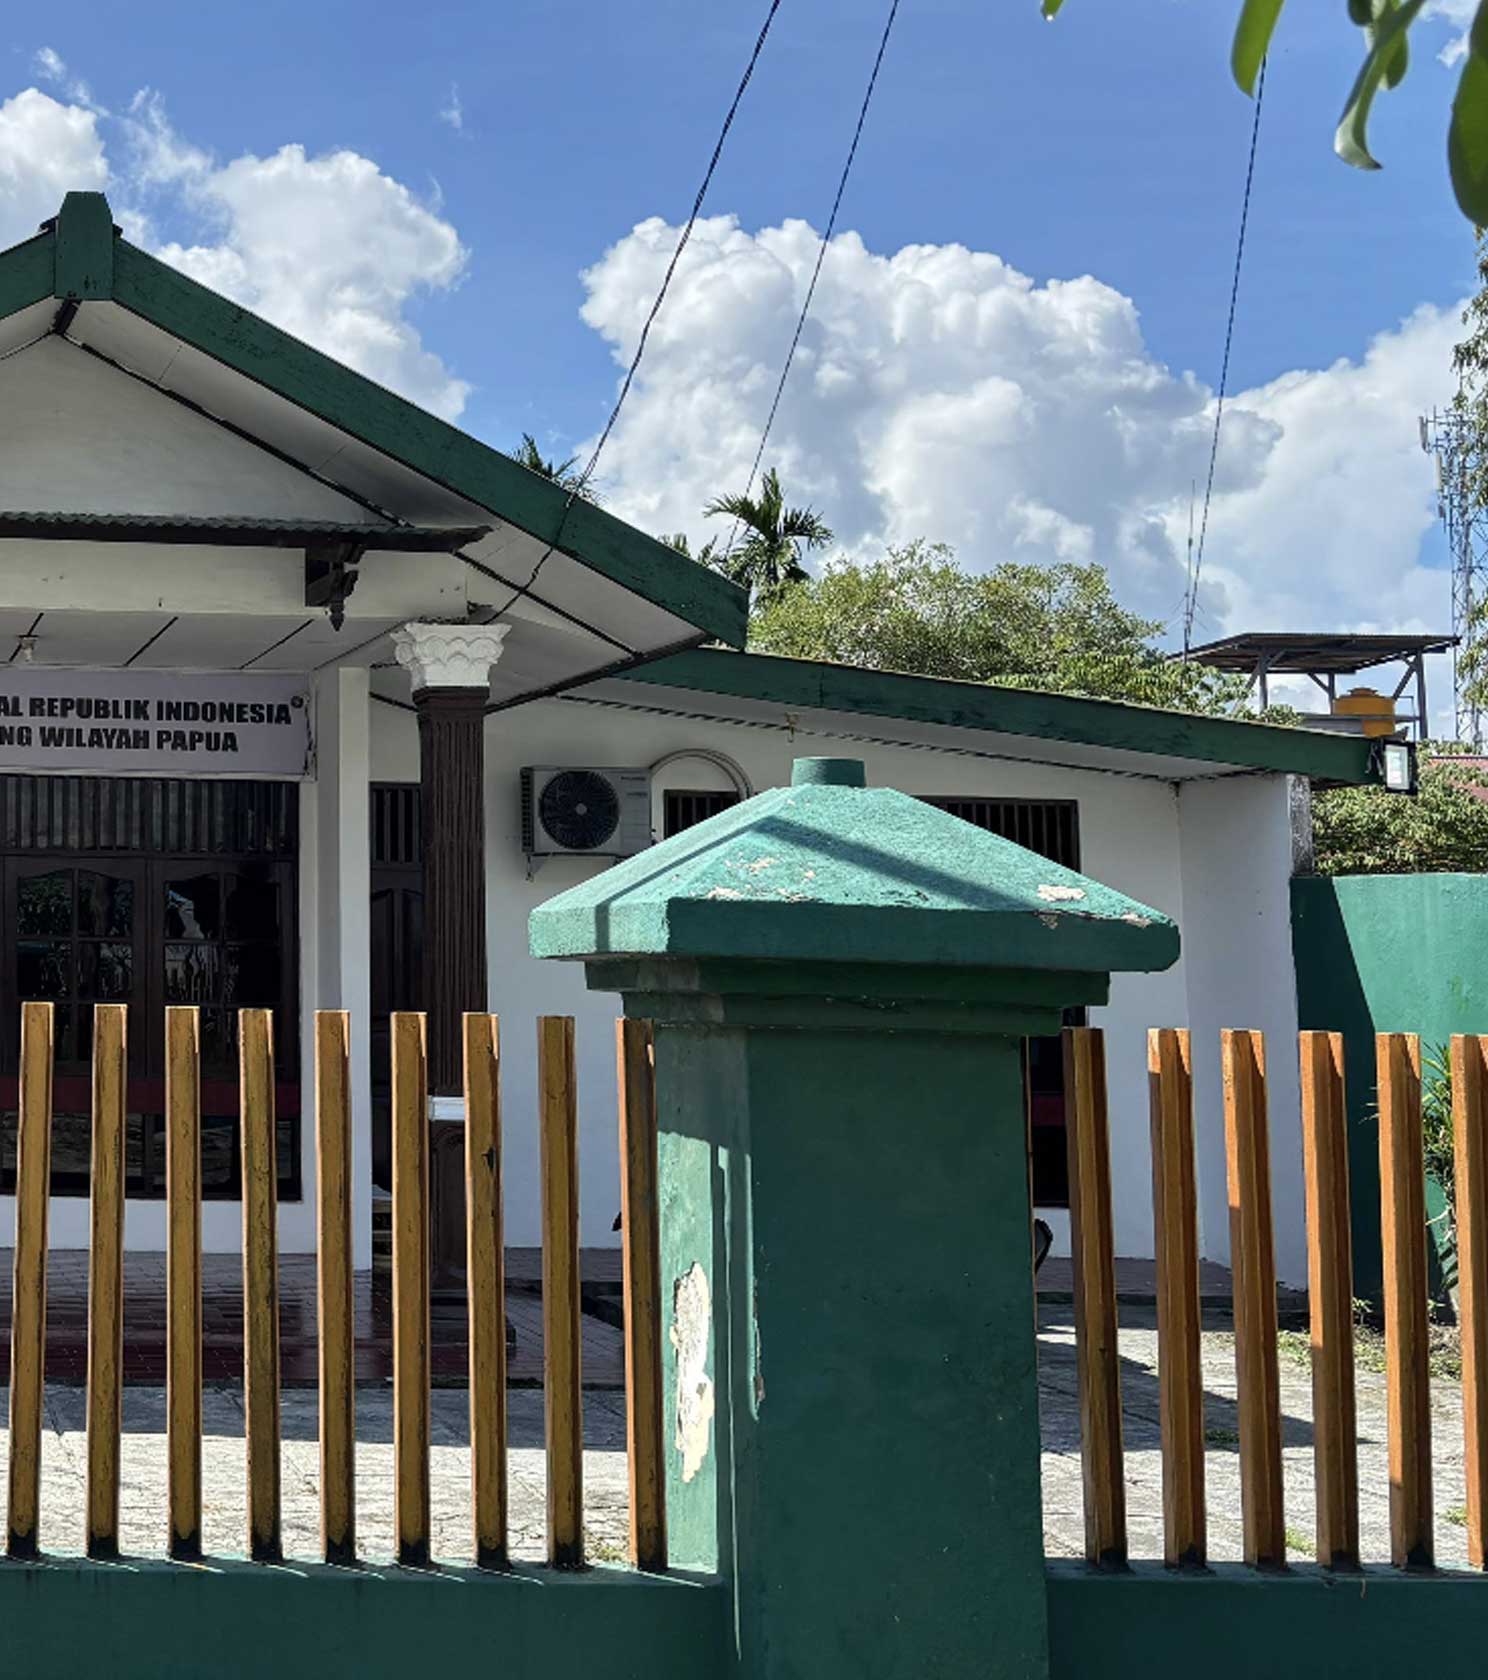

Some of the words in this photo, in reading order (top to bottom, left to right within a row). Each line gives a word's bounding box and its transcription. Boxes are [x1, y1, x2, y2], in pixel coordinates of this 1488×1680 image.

[29, 697, 149, 720] REPUBLIK
[157, 700, 291, 724] INDONESIA
[39, 726, 149, 750] WILAYAH
[157, 730, 238, 752] PAPUA
